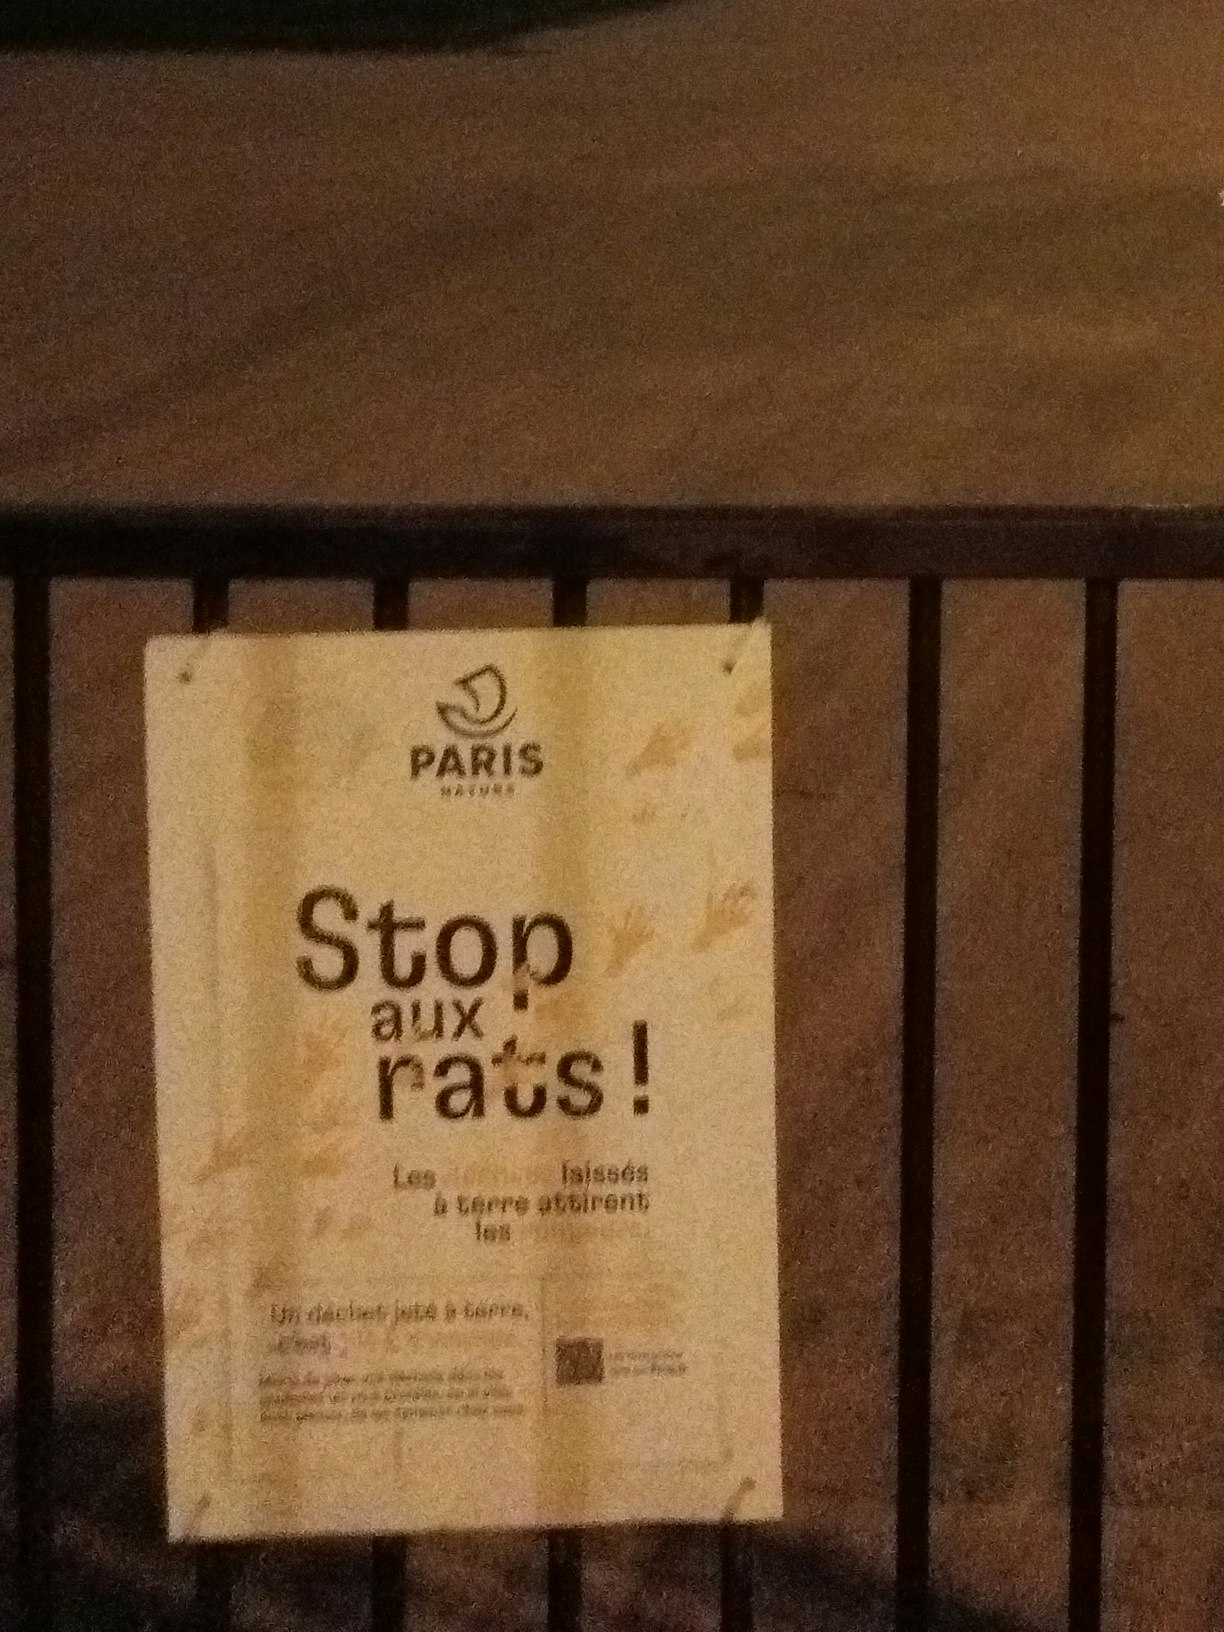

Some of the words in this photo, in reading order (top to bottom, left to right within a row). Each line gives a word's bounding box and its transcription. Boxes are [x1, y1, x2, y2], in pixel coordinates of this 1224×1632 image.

[410, 742, 545, 780] PARIS
[296, 884, 574, 1011] Stop
[369, 997, 486, 1042] aux
[392, 1163, 438, 1190] Les
[561, 1159, 650, 1186] laissés
[433, 1191, 448, 1216] à
[456, 1194, 530, 1217] terre
[537, 1190, 651, 1217] attirent
[474, 1219, 511, 1243] les
